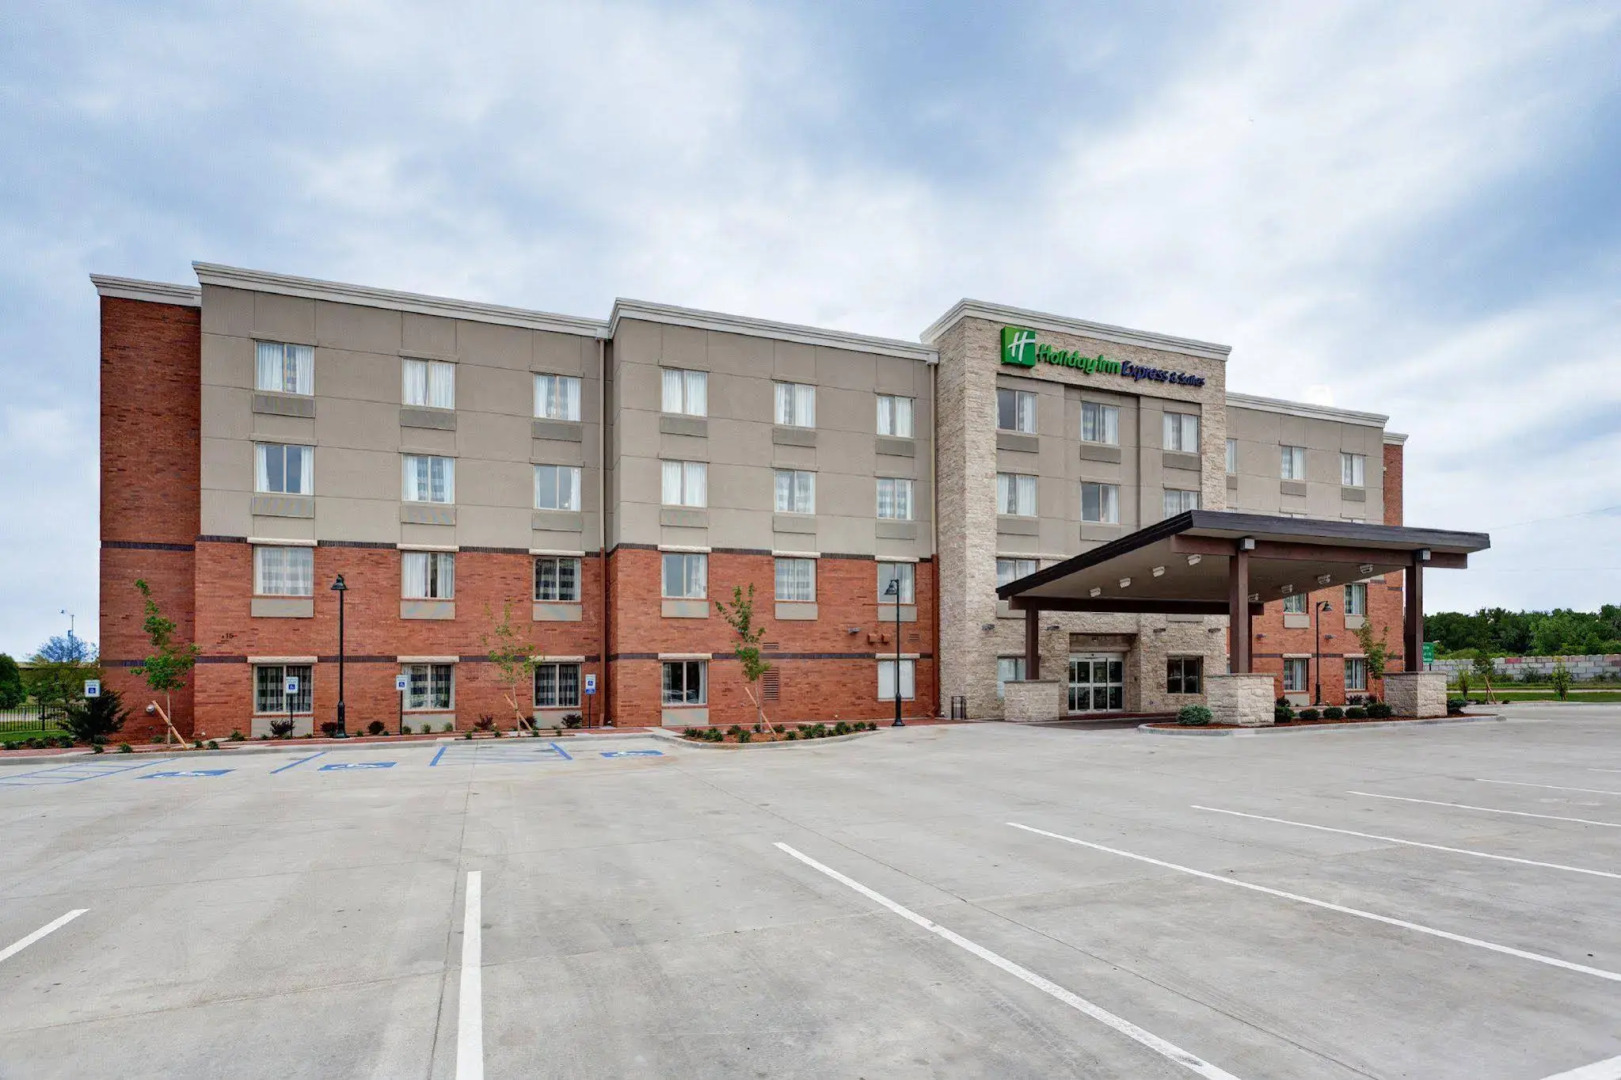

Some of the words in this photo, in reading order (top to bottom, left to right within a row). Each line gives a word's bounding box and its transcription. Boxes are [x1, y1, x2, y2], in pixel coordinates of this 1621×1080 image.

[1037, 343, 1096, 375] Holiday
[1096, 354, 1121, 374] Inn
[1121, 360, 1169, 382] Express
[1169, 371, 1178, 384] &
[1177, 372, 1205, 387] Suites
